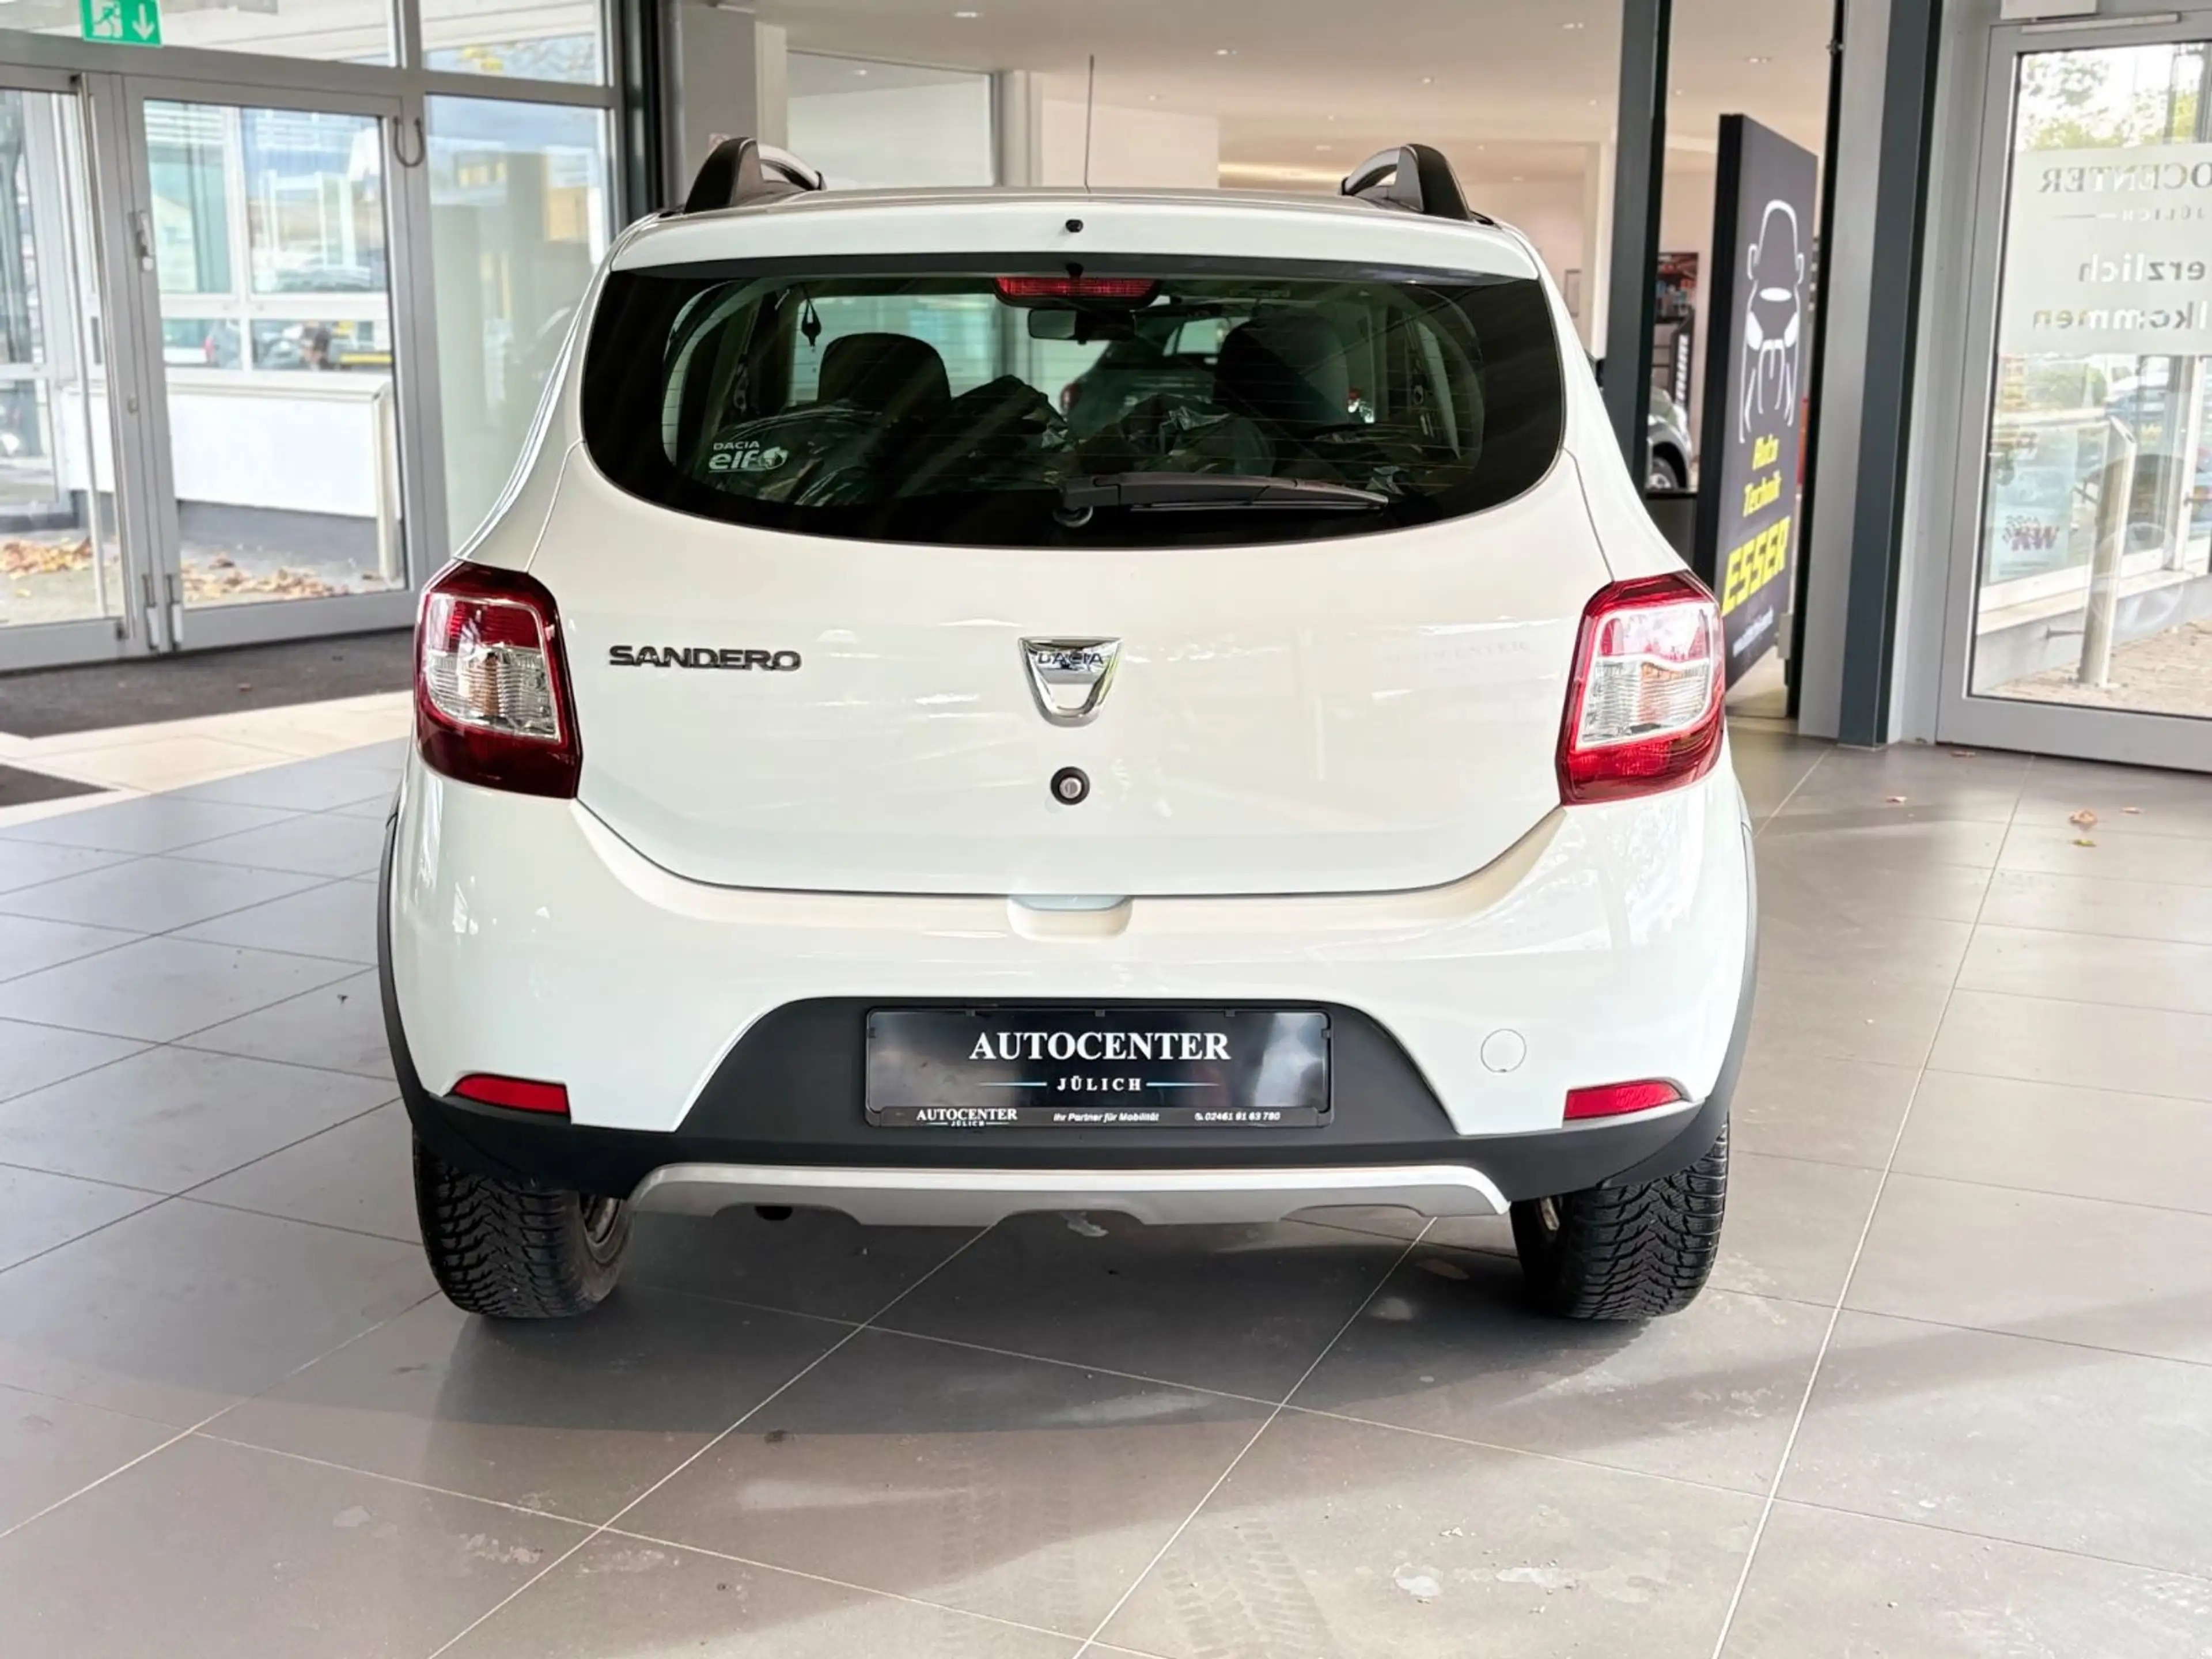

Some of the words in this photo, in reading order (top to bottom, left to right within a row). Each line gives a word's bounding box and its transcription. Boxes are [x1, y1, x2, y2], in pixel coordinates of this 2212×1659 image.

[713, 441, 760, 450] DACIA
[1721, 515, 1791, 617] ESSER
[609, 645, 802, 671] SANDERO
[1037, 652, 1104, 665] DACIA
[968, 1031, 1232, 1061] AUTOCENTER
[1056, 1075, 1142, 1092] JÜLICH
[916, 1108, 1018, 1120] AUTOCENTER
[1068, 1112, 1103, 1122] Partner
[1204, 1111, 1233, 1121] 02461
